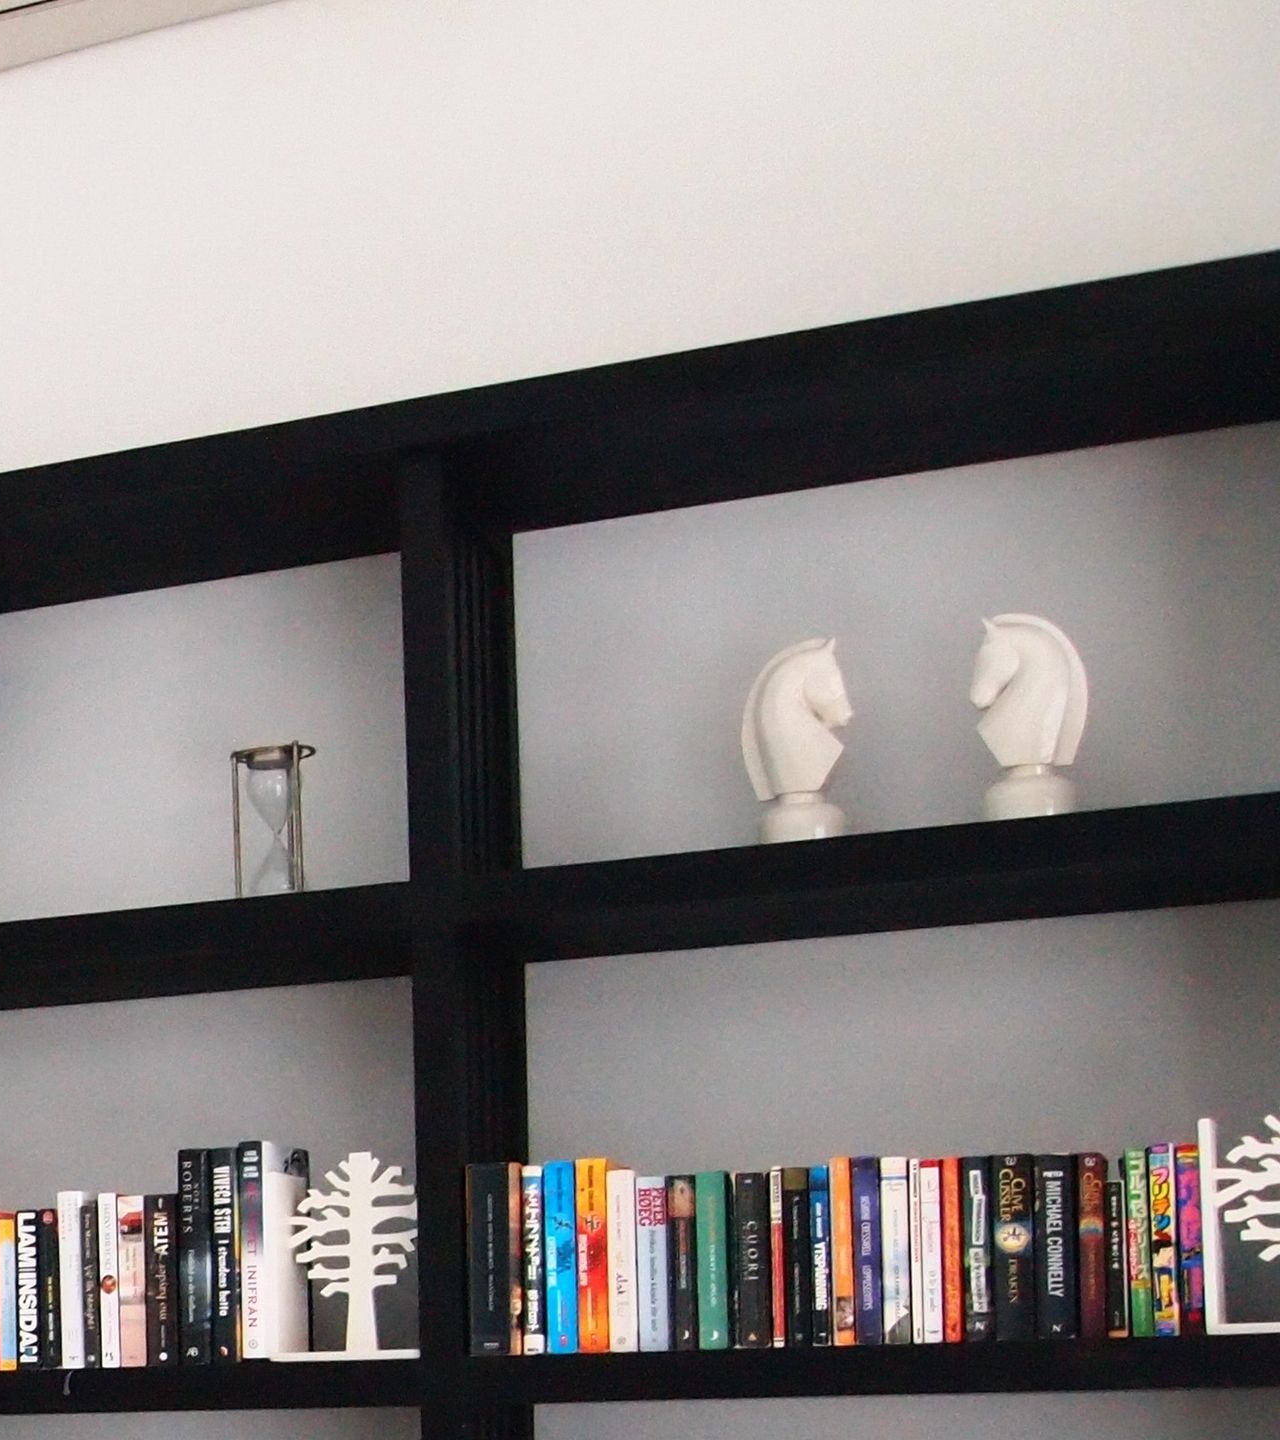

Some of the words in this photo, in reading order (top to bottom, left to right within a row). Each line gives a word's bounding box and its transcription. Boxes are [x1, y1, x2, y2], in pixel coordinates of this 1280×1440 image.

[182, 1161, 193, 1234] ROBERTS
[651, 1186, 665, 1226] PETER
[1045, 1180, 1064, 1234] MICHAEL
[746, 1220, 759, 1281] CUORI
[1047, 1236, 1065, 1298] CONNELLY
